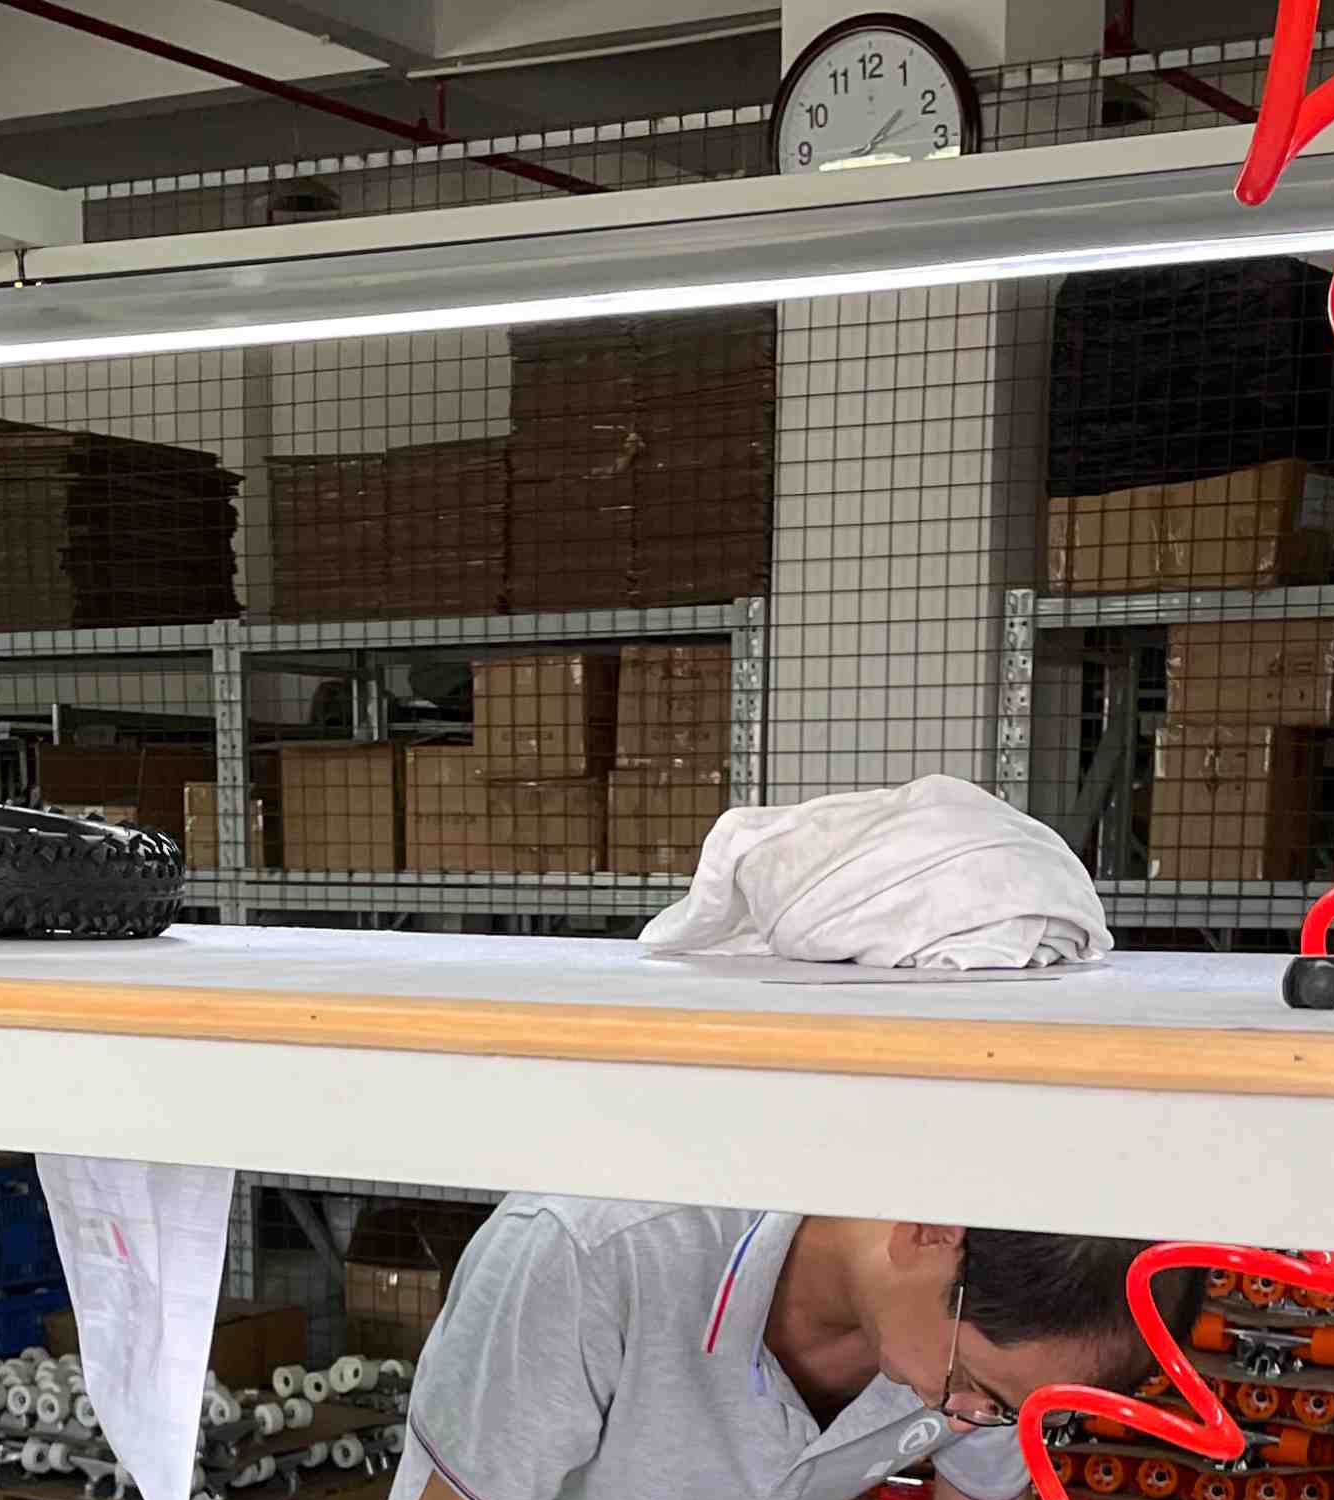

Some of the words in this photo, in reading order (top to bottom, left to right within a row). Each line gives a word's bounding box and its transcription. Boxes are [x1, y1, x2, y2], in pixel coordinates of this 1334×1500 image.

[857, 53, 883, 80] 12
[898, 60, 908, 86] 1
[829, 67, 849, 95] 11
[920, 90, 937, 115] 2
[805, 103, 828, 129] 10
[933, 124, 949, 150] 3
[798, 141, 812, 166] 9
